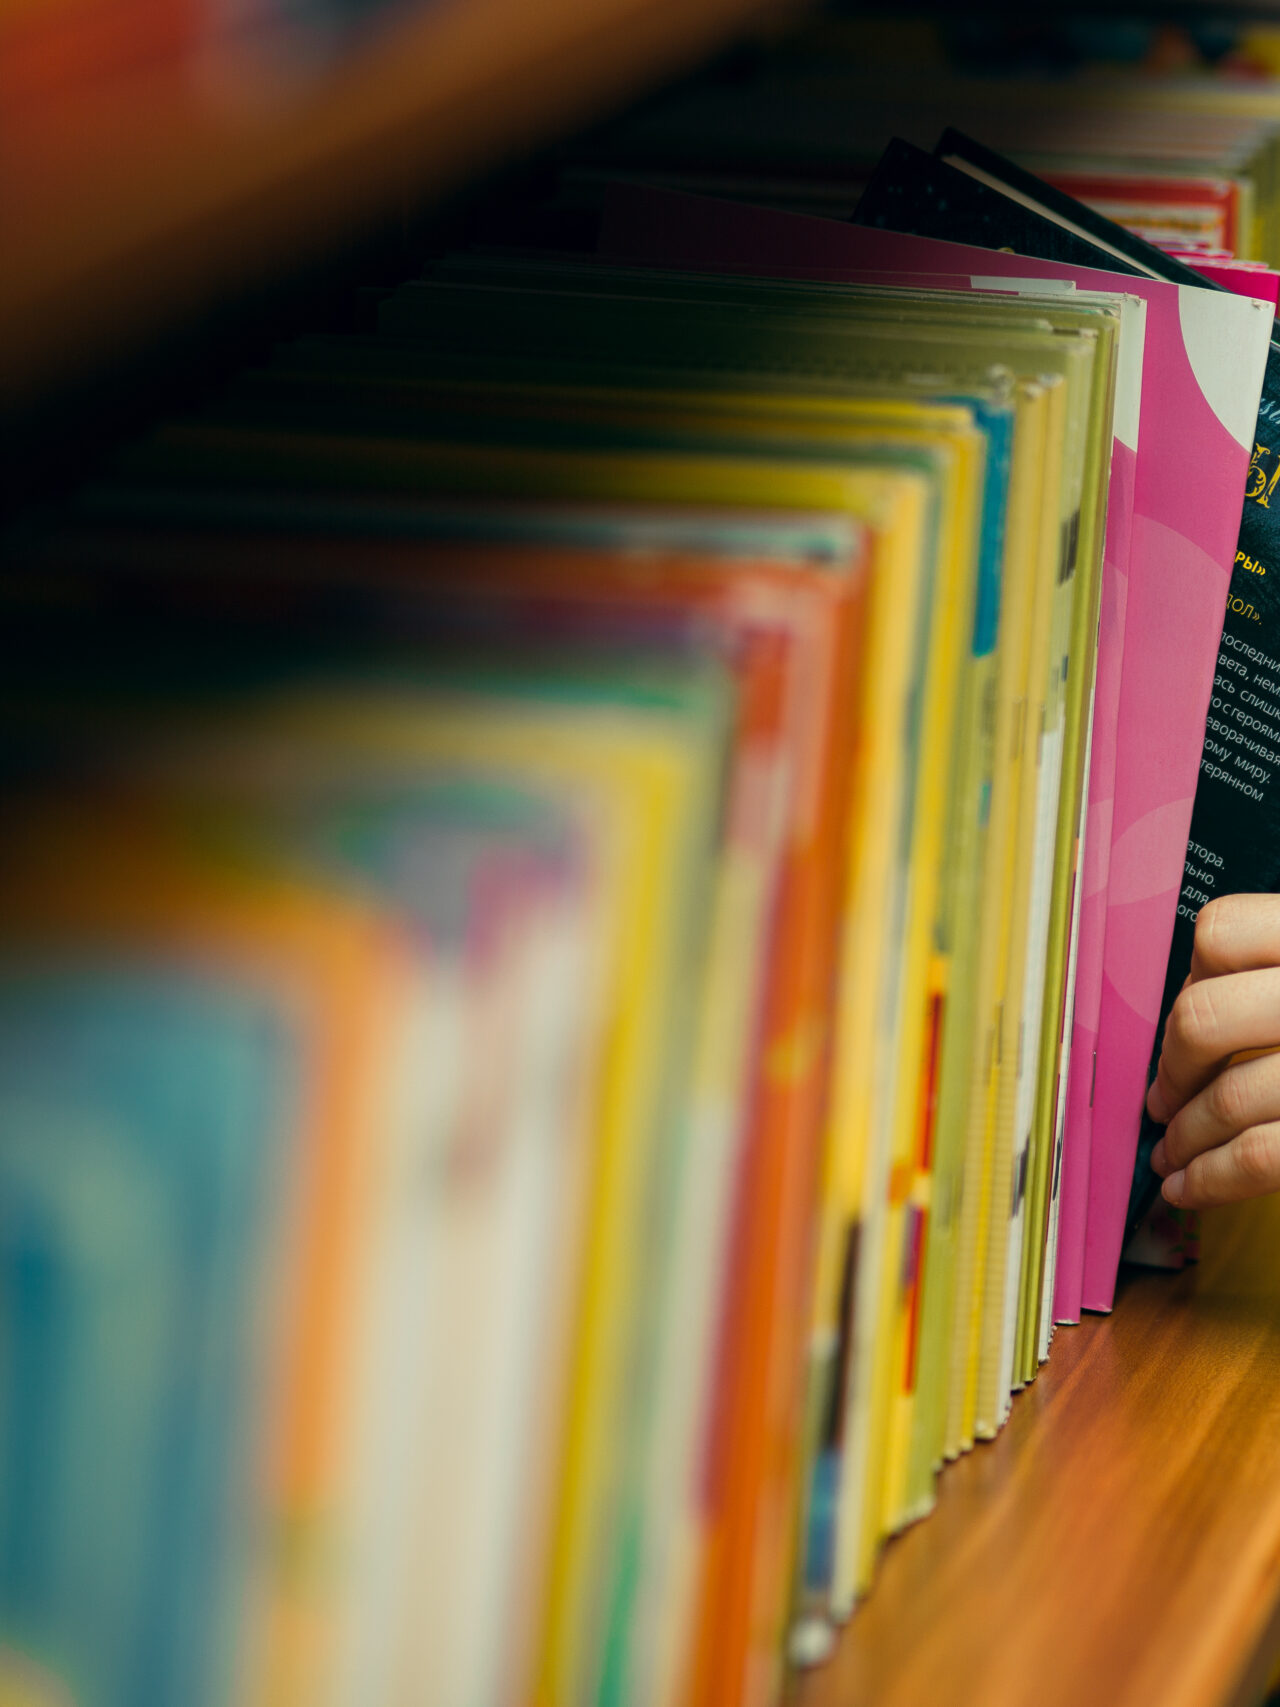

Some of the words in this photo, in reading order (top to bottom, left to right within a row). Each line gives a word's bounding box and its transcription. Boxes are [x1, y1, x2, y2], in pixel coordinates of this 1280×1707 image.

[1234, 550, 1266, 576] РЫ»
[1218, 652, 1249, 681] вета,
[1213, 674, 1236, 694] ась
[1210, 695, 1222, 709] о
[1222, 703, 1232, 714] с
[1204, 737, 1232, 762] ому
[1234, 755, 1271, 785] миру.
[1200, 759, 1264, 803] терянном
[1186, 839, 1225, 871] втора.
[1184, 860, 1216, 888] льно.
[1181, 885, 1210, 904] для
[1177, 904, 1199, 923] ого
